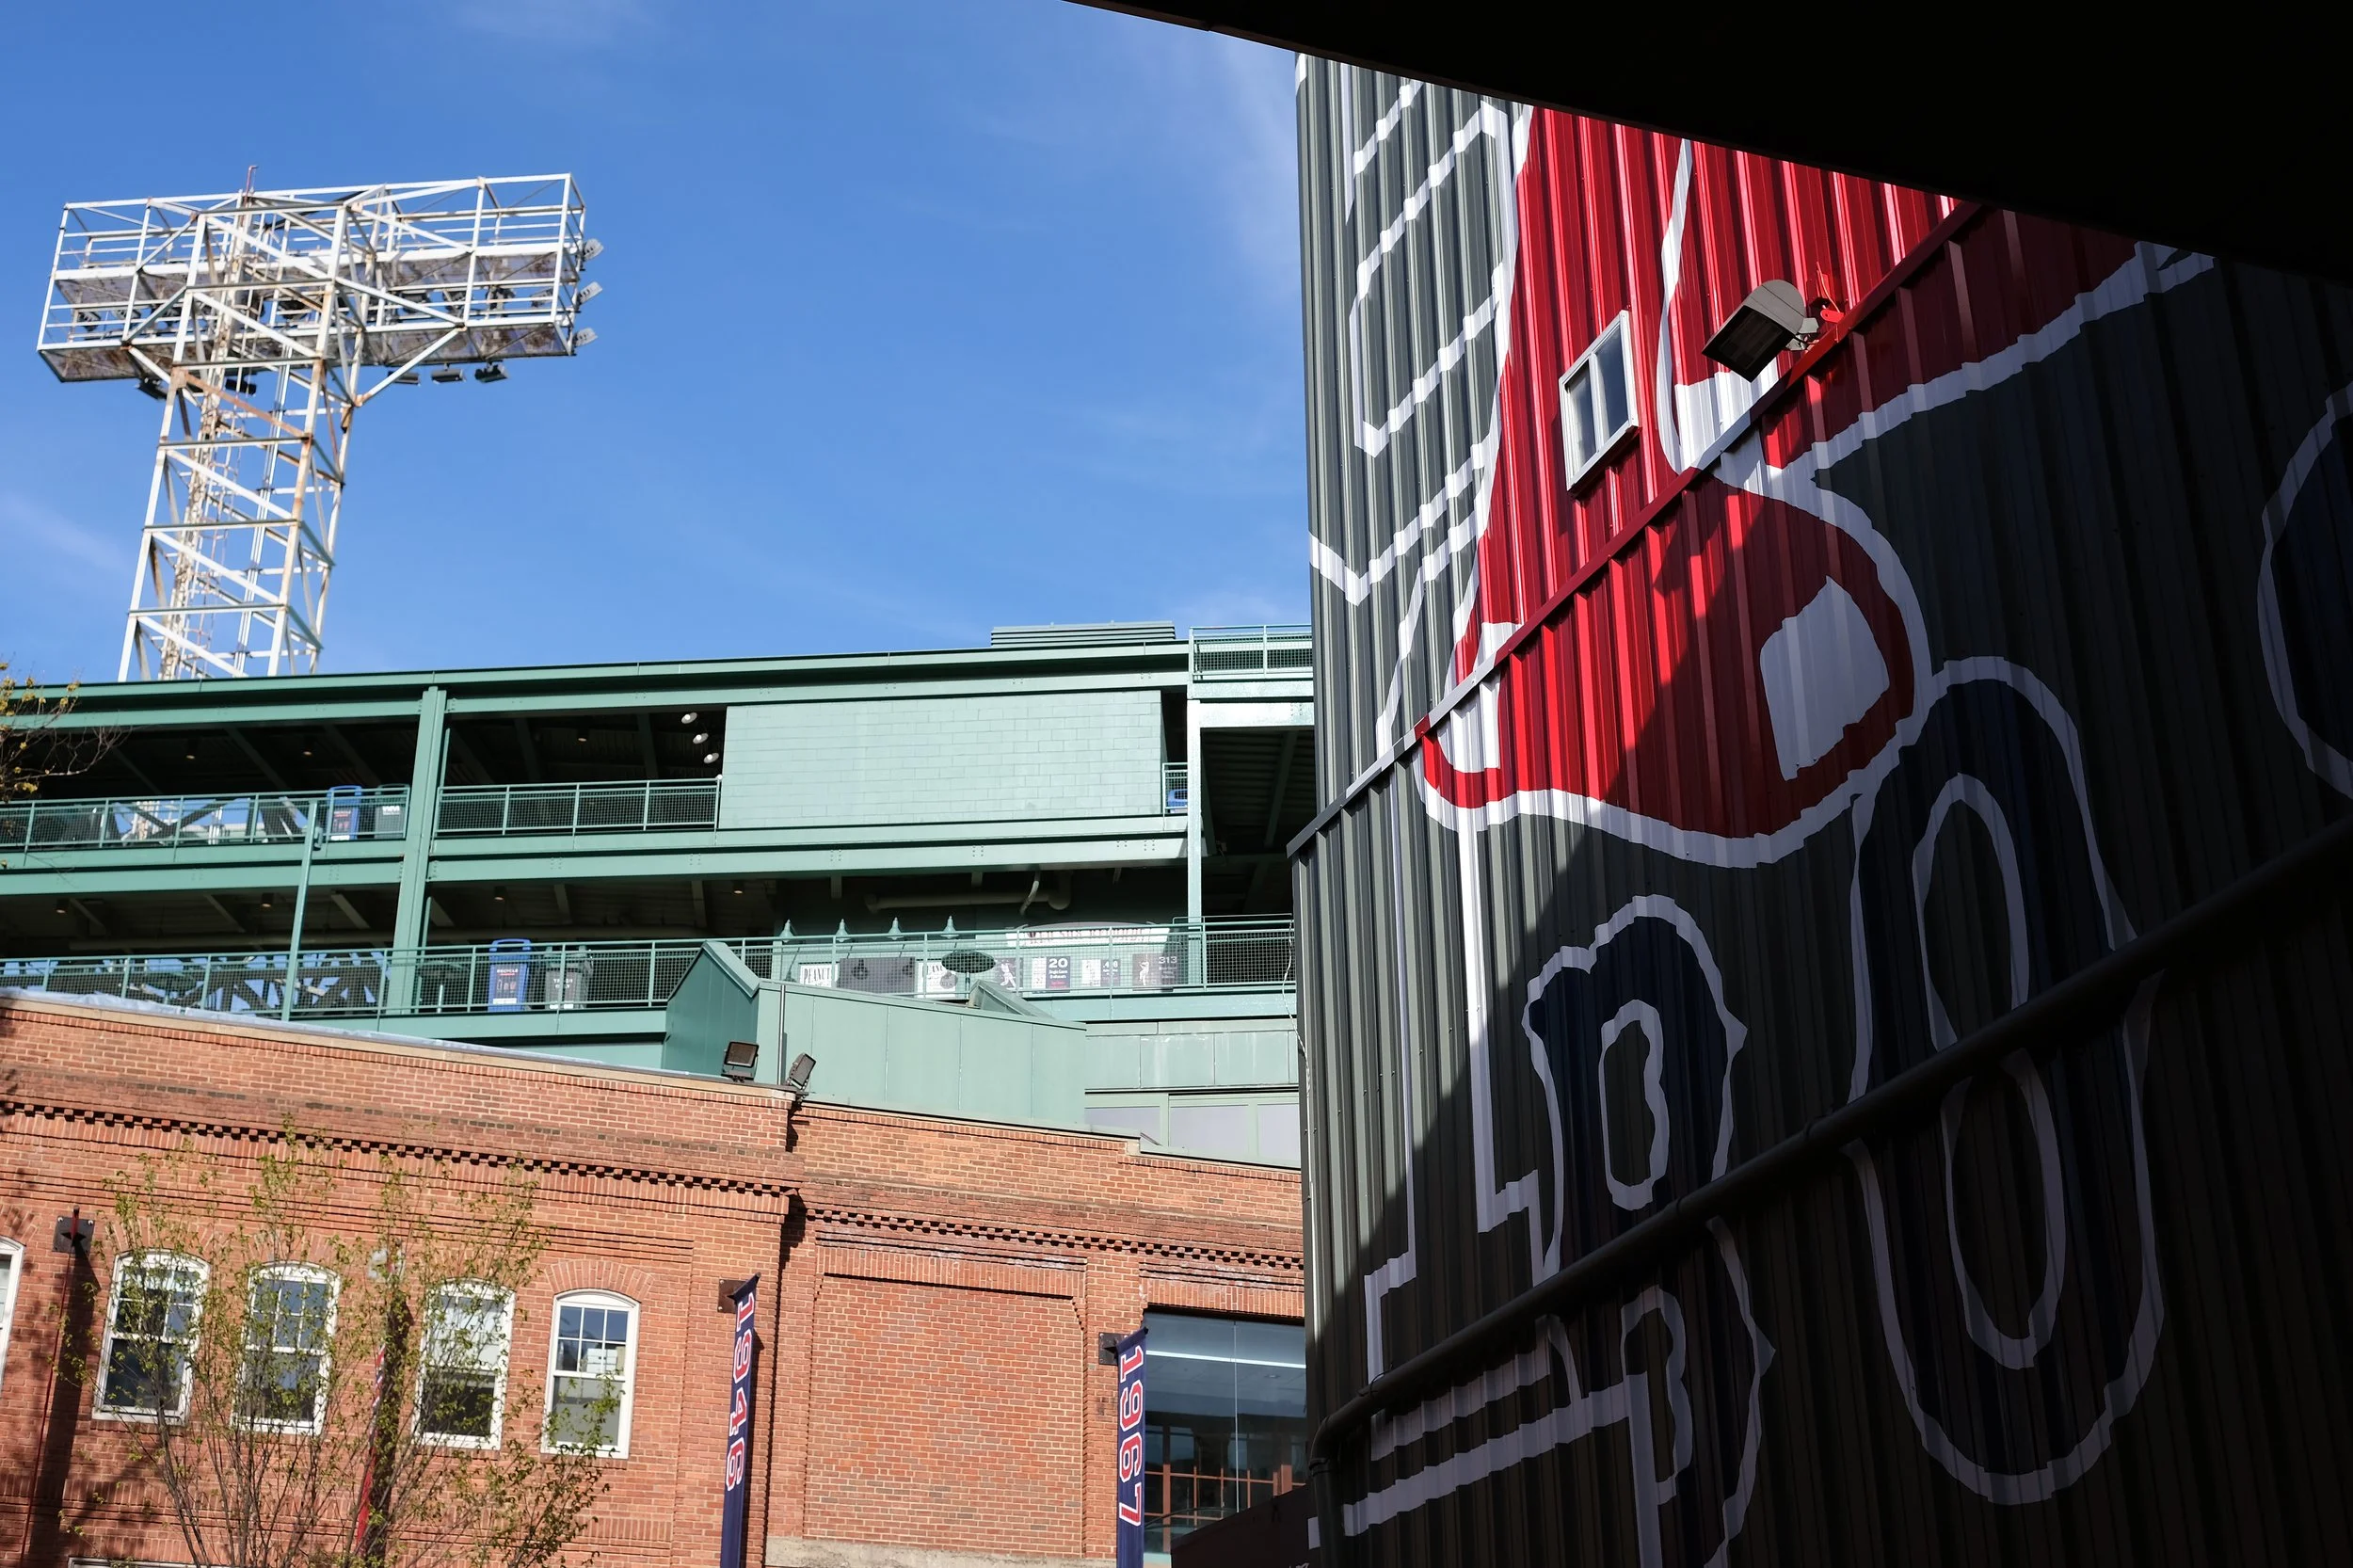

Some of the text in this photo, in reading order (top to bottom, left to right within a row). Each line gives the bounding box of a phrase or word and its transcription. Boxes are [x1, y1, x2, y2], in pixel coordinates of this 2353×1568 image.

[1048, 958, 1068, 968] 20
[726, 1292, 755, 1492] 1946
[1118, 1345, 1144, 1527] 1967
